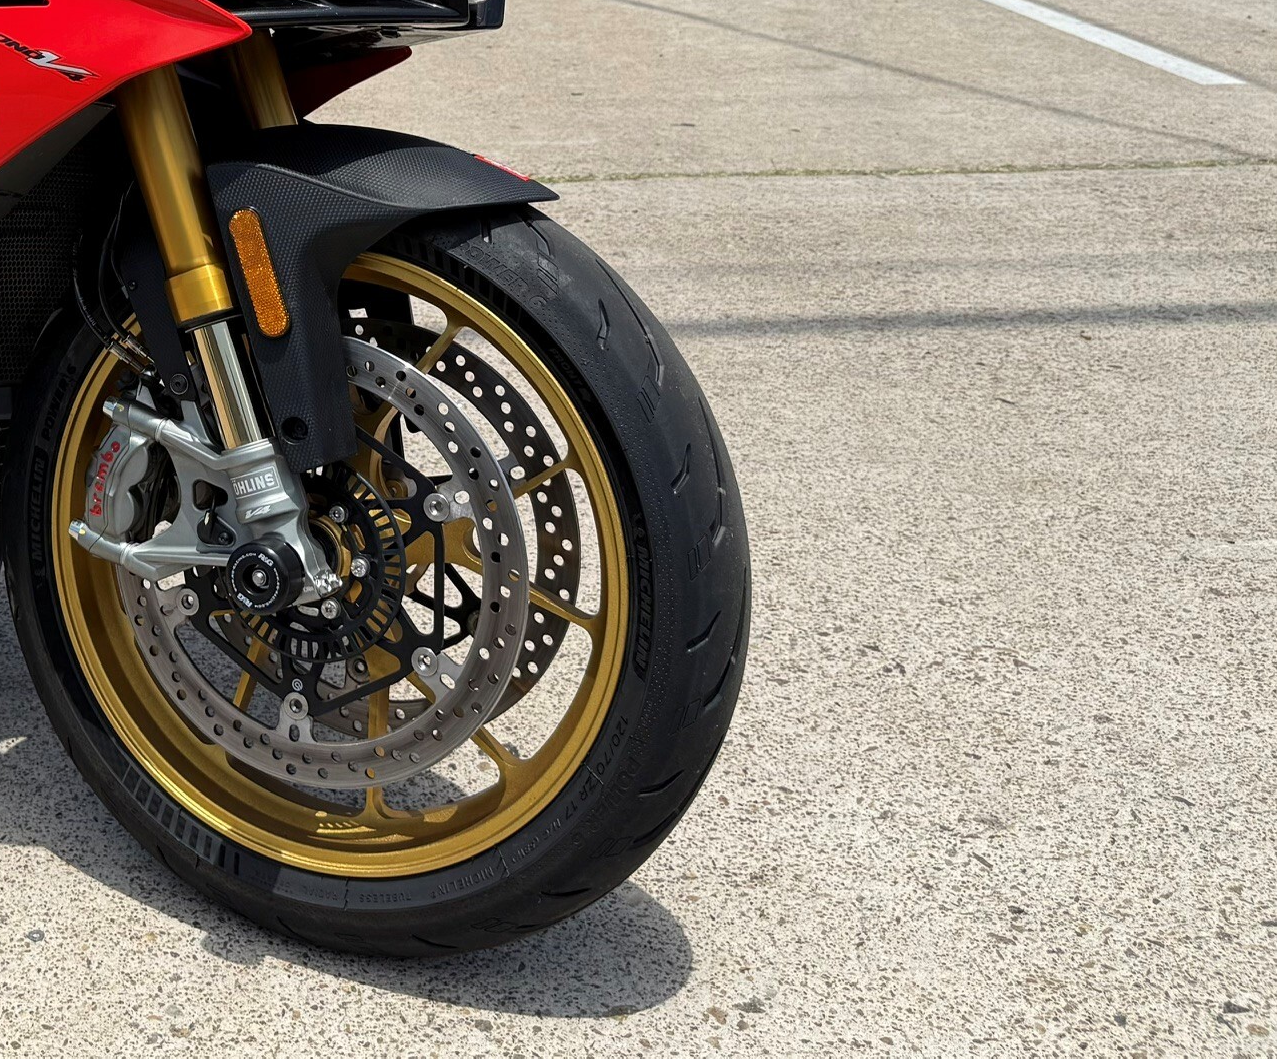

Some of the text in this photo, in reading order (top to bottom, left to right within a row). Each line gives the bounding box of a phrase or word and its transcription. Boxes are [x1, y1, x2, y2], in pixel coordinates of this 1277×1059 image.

[31, 457, 47, 566] MICHELIN
[90, 441, 121, 518] brembo
[232, 473, 275, 496] ÖHLINS
[635, 545, 653, 672] MICHELIN
